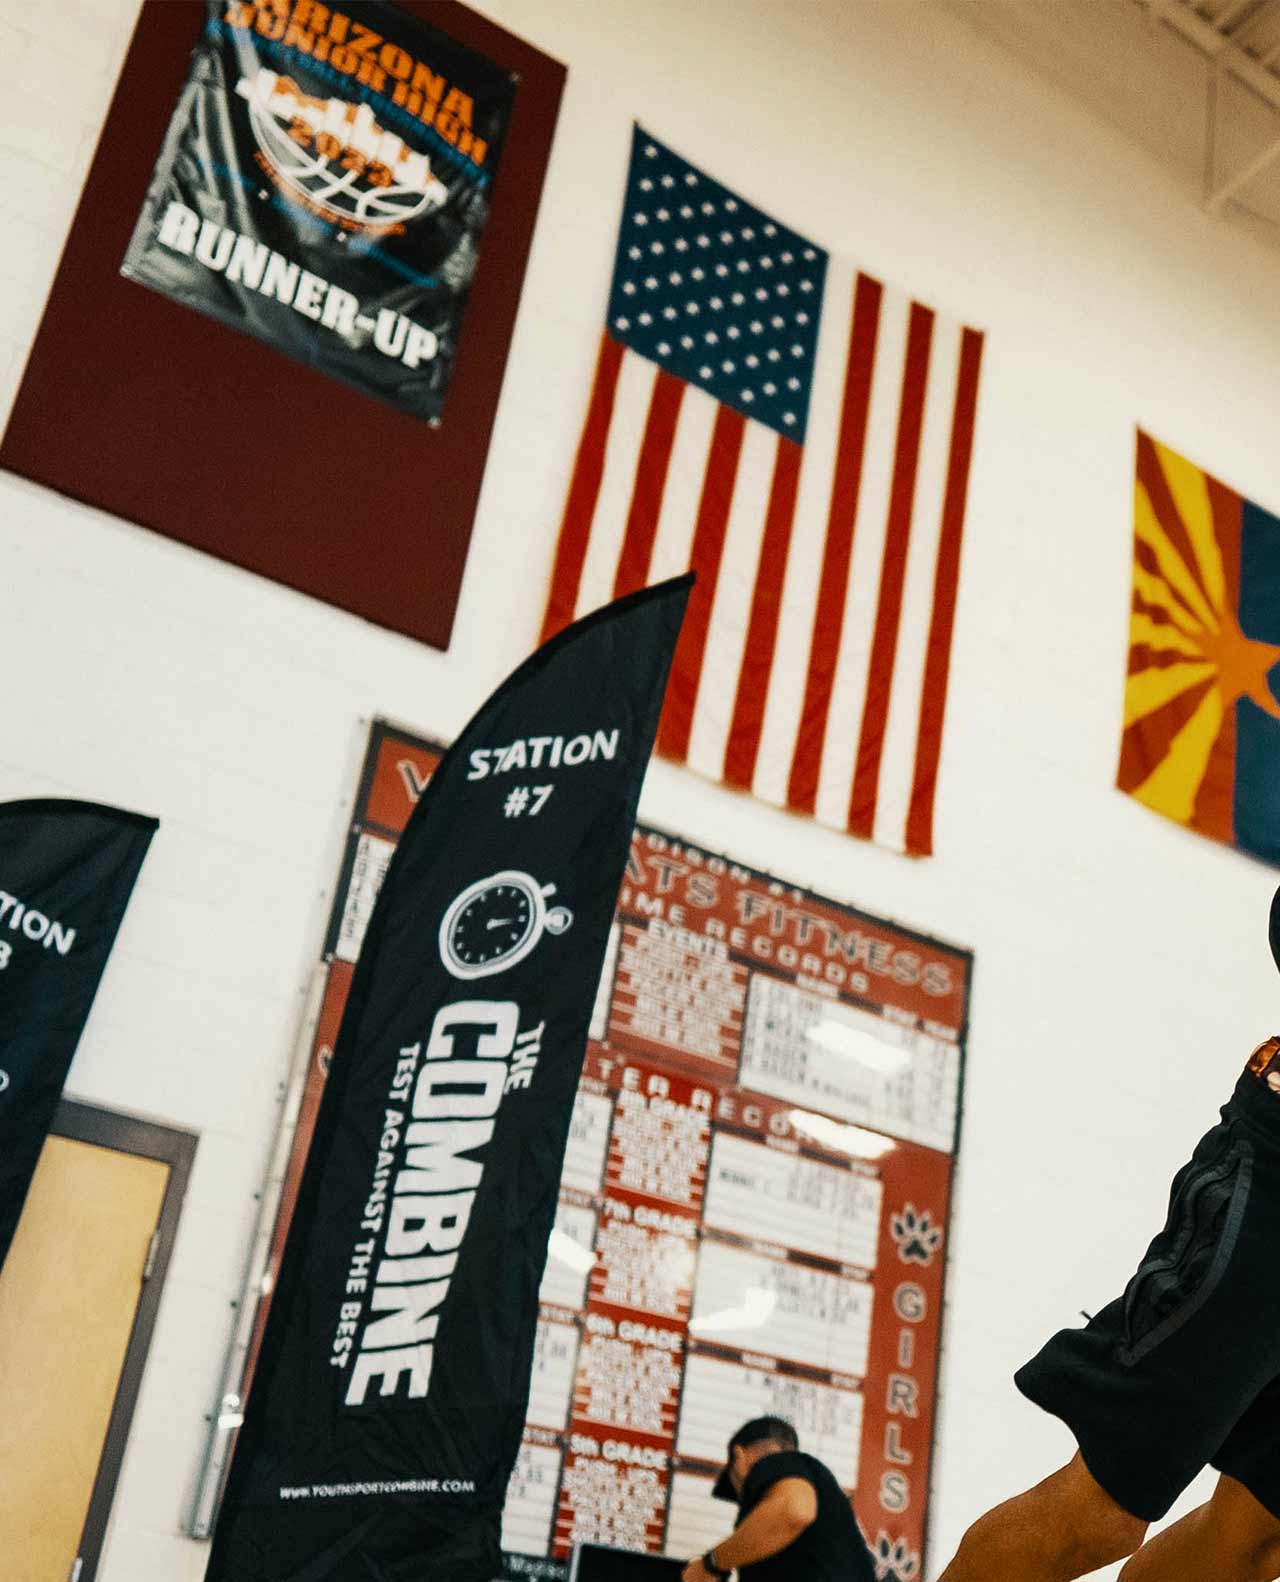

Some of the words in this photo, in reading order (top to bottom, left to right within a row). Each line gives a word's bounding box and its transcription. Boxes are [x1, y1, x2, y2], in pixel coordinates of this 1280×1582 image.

[225, 2, 387, 92] JUNIOR
[392, 81, 488, 166] HIGH
[250, 0, 474, 129] ARIZONA
[156, 200, 439, 370] RUNNER-UP
[466, 728, 620, 780] STATION
[503, 784, 554, 818] #7
[704, 918, 870, 995] RECORDS
[737, 888, 954, 998] FITNESS
[387, 1041, 421, 1102] TEST
[504, 1020, 546, 1096] THE
[345, 1000, 520, 1406] COMBINE
[361, 1107, 404, 1233] AGAINST
[633, 1204, 698, 1240] GRADE
[345, 1237, 376, 1296] THE
[330, 1300, 363, 1369] BEST
[618, 1319, 684, 1350] GRADE
[878, 1280, 928, 1513] GIRLS
[601, 1438, 668, 1469] GRADE
